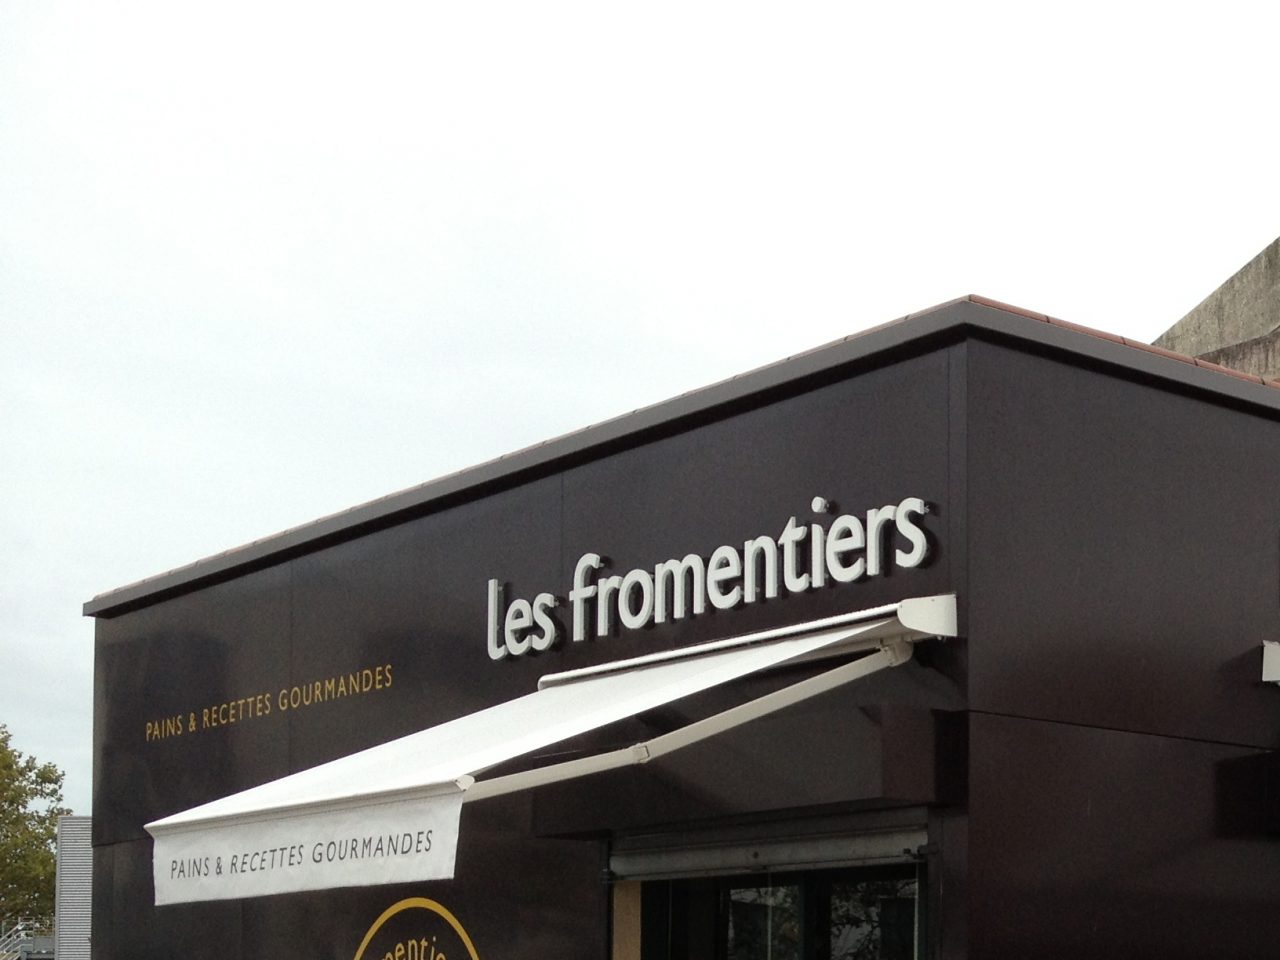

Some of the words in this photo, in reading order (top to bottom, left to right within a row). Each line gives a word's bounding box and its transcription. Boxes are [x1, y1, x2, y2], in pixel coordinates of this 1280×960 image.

[488, 578, 557, 660] les
[569, 496, 927, 642] fromentiers
[146, 715, 182, 741] PAINS
[188, 712, 196, 733] &
[202, 693, 271, 729] RECETTES
[278, 664, 393, 711] GOURMANDES
[170, 856, 209, 879] PAINS
[215, 856, 223, 875] &
[230, 844, 304, 875] RECETTES
[312, 830, 433, 864] GOURMANDES
